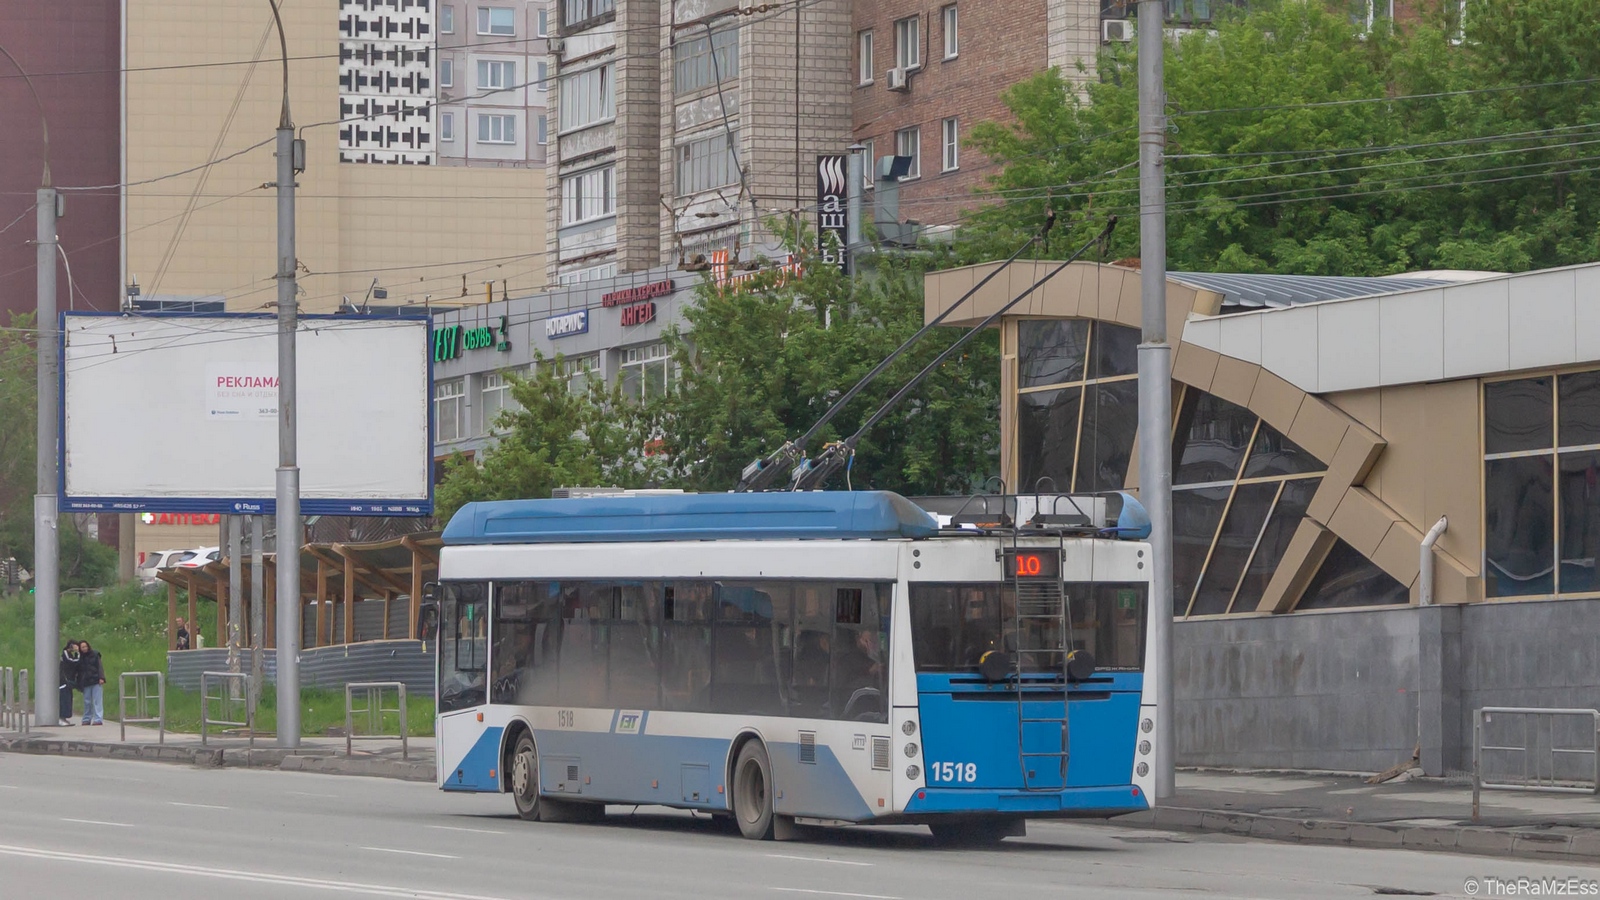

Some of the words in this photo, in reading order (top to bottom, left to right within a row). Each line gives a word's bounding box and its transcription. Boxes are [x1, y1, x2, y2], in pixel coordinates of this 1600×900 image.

[602, 279, 672, 308] ПАРИКМАХЕРСКАЯ
[546, 312, 585, 336] НОТАРИУС
[621, 302, 654, 327] АНГЕЛ
[433, 324, 458, 362] EST
[464, 326, 491, 350] ОБУВЬ
[1016, 555, 1041, 576] 10
[557, 710, 574, 728] 1518
[932, 761, 977, 782] 1518
